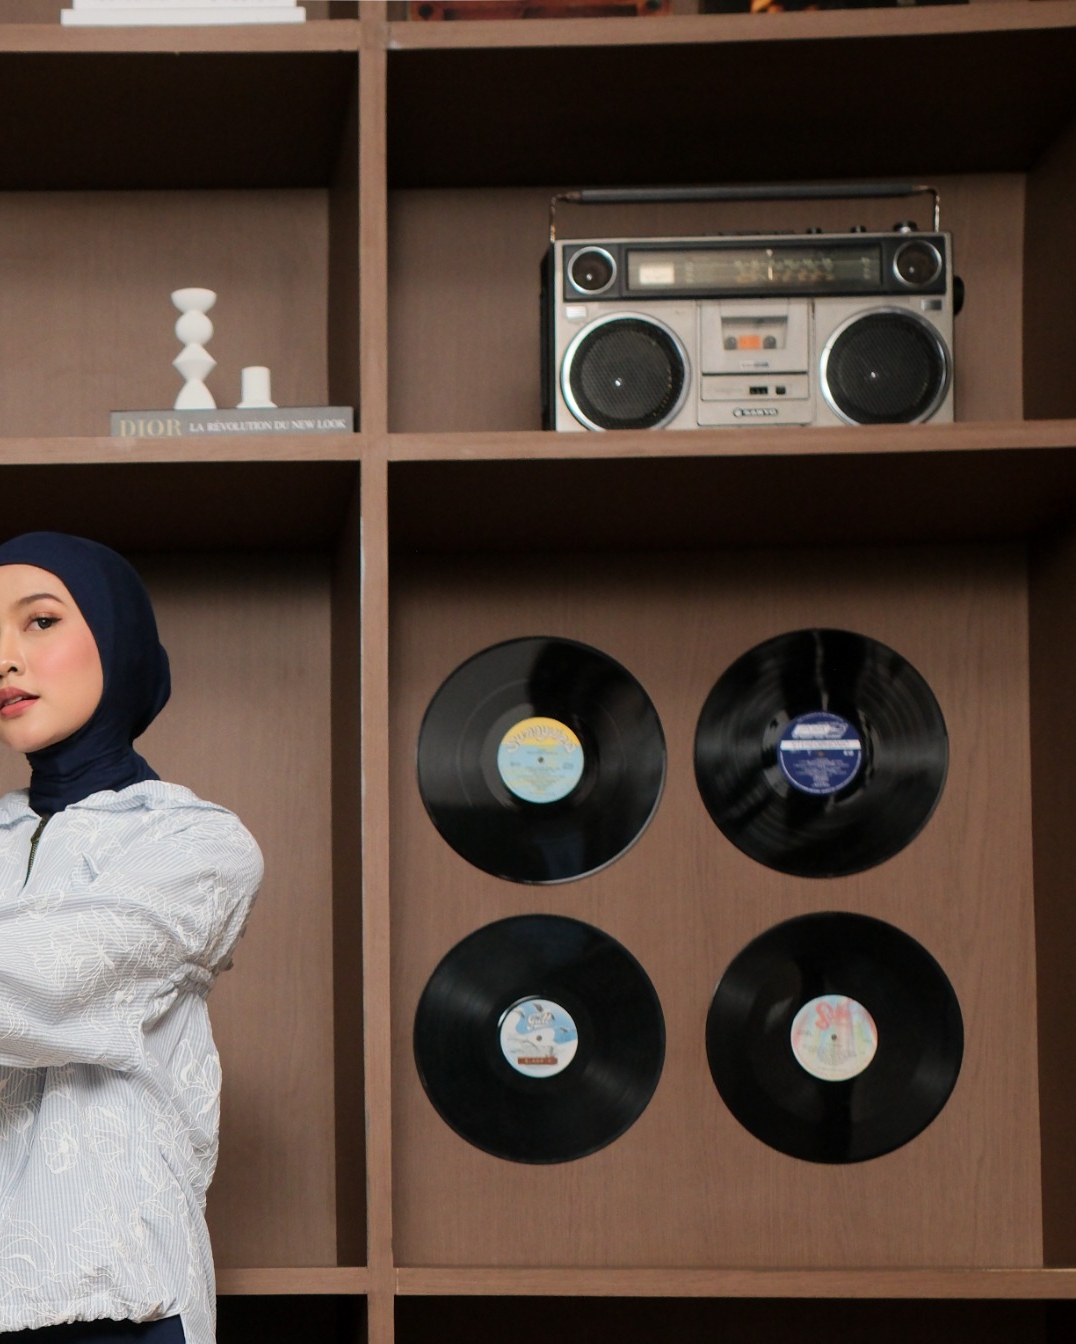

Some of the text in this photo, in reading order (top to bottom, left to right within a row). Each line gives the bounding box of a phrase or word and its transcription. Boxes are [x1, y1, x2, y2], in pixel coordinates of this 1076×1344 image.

[120, 419, 182, 437] DIOR
[189, 422, 205, 432] LA
[274, 420, 289, 430] DU
[291, 420, 315, 430] NEW
[317, 419, 346, 429] LOOK
